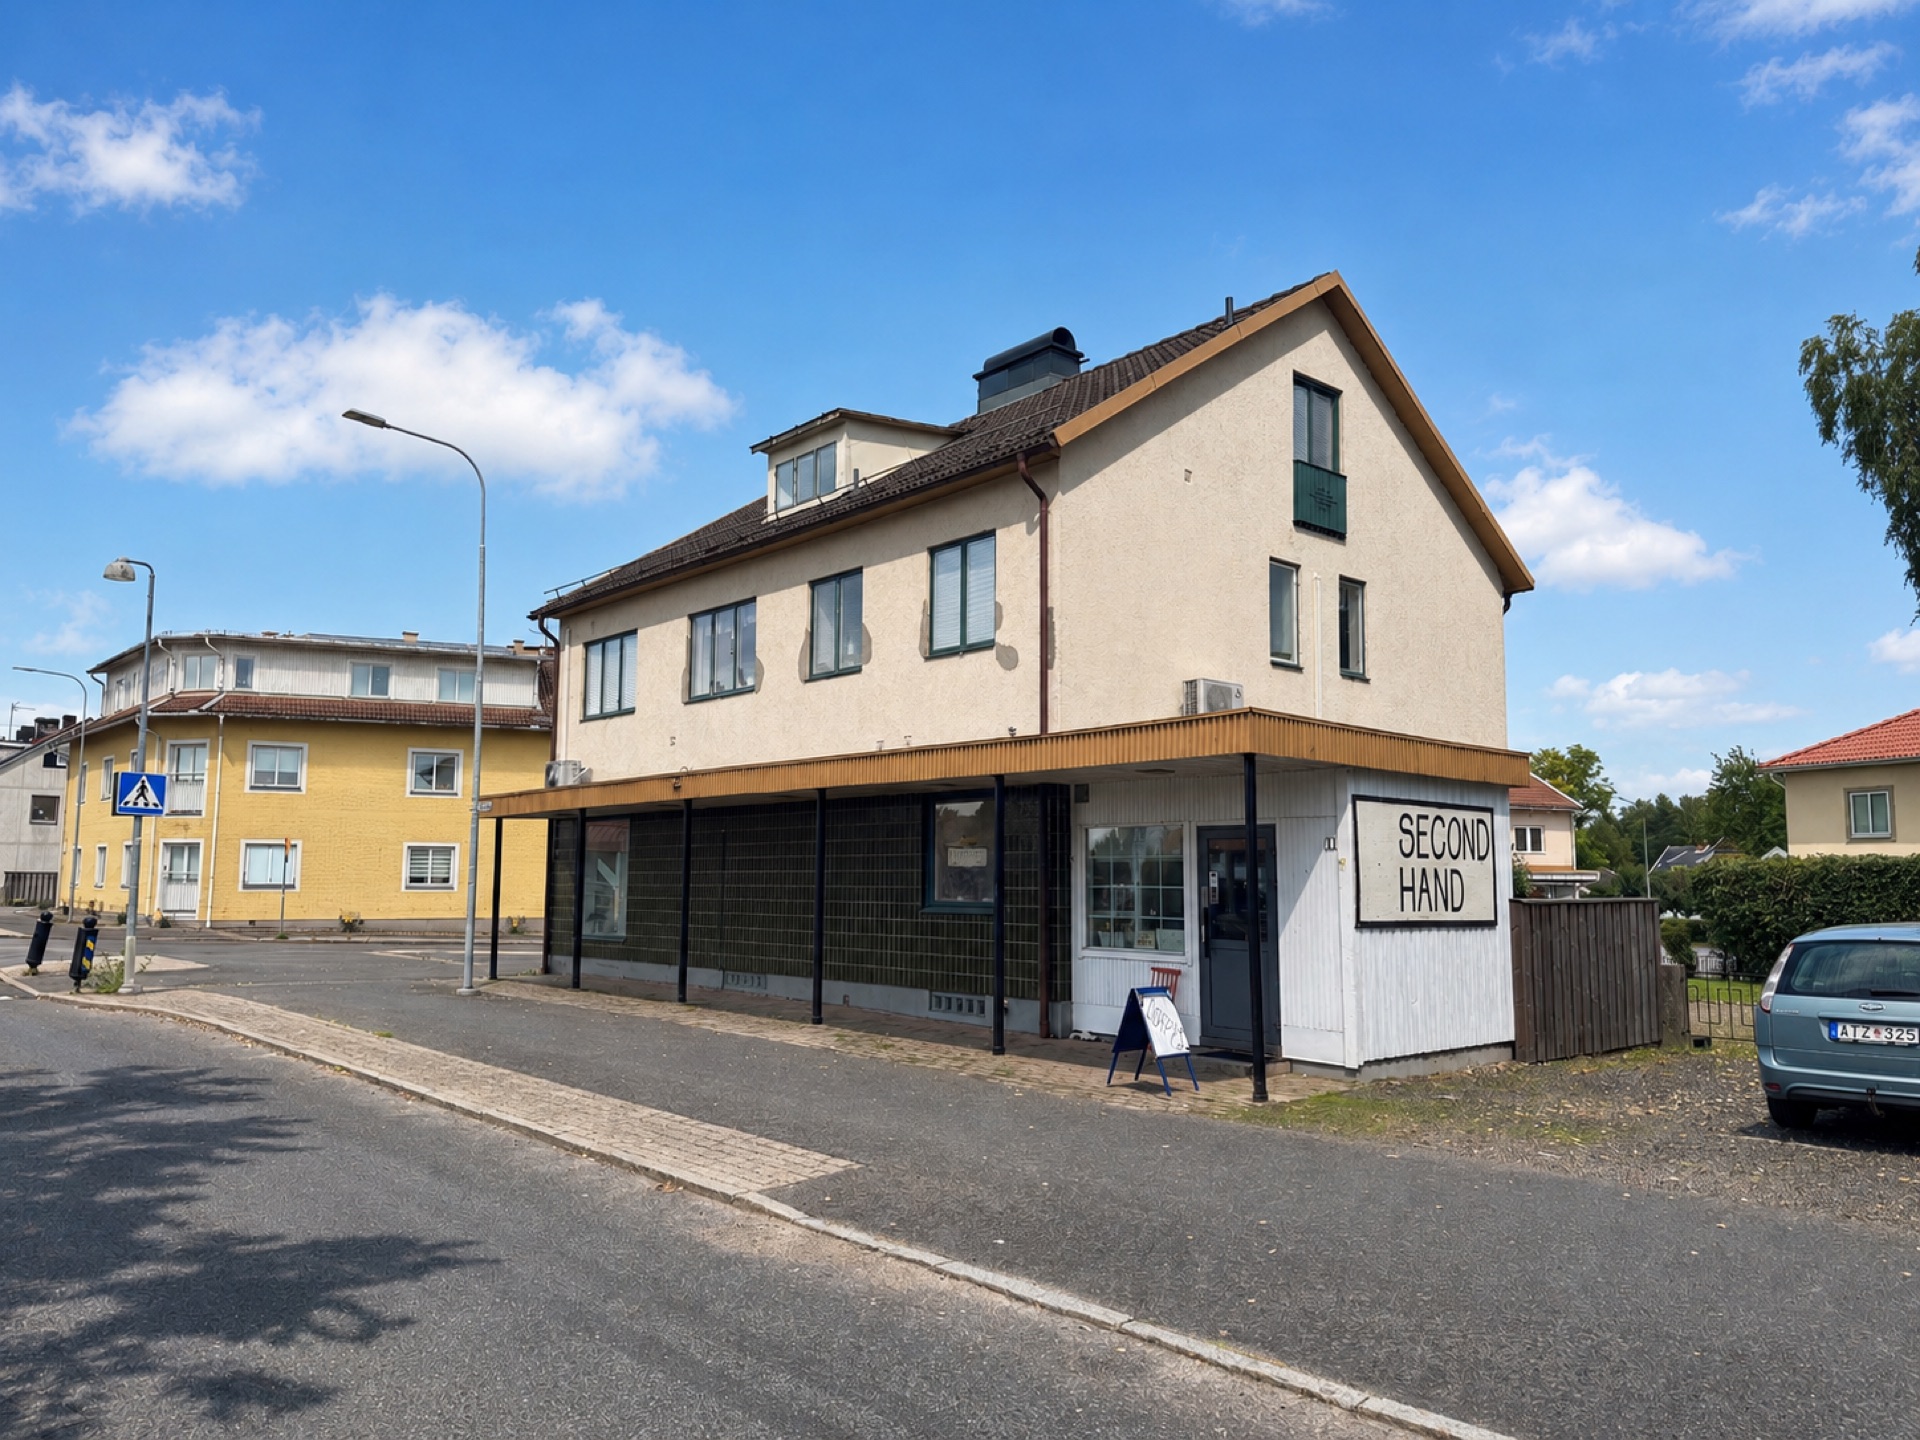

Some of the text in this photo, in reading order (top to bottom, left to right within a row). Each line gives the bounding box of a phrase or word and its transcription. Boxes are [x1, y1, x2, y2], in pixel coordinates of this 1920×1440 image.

[1399, 813, 1490, 862] SECOND
[1400, 867, 1465, 912] HAND
[1840, 1024, 1916, 1042] ATZ 325
